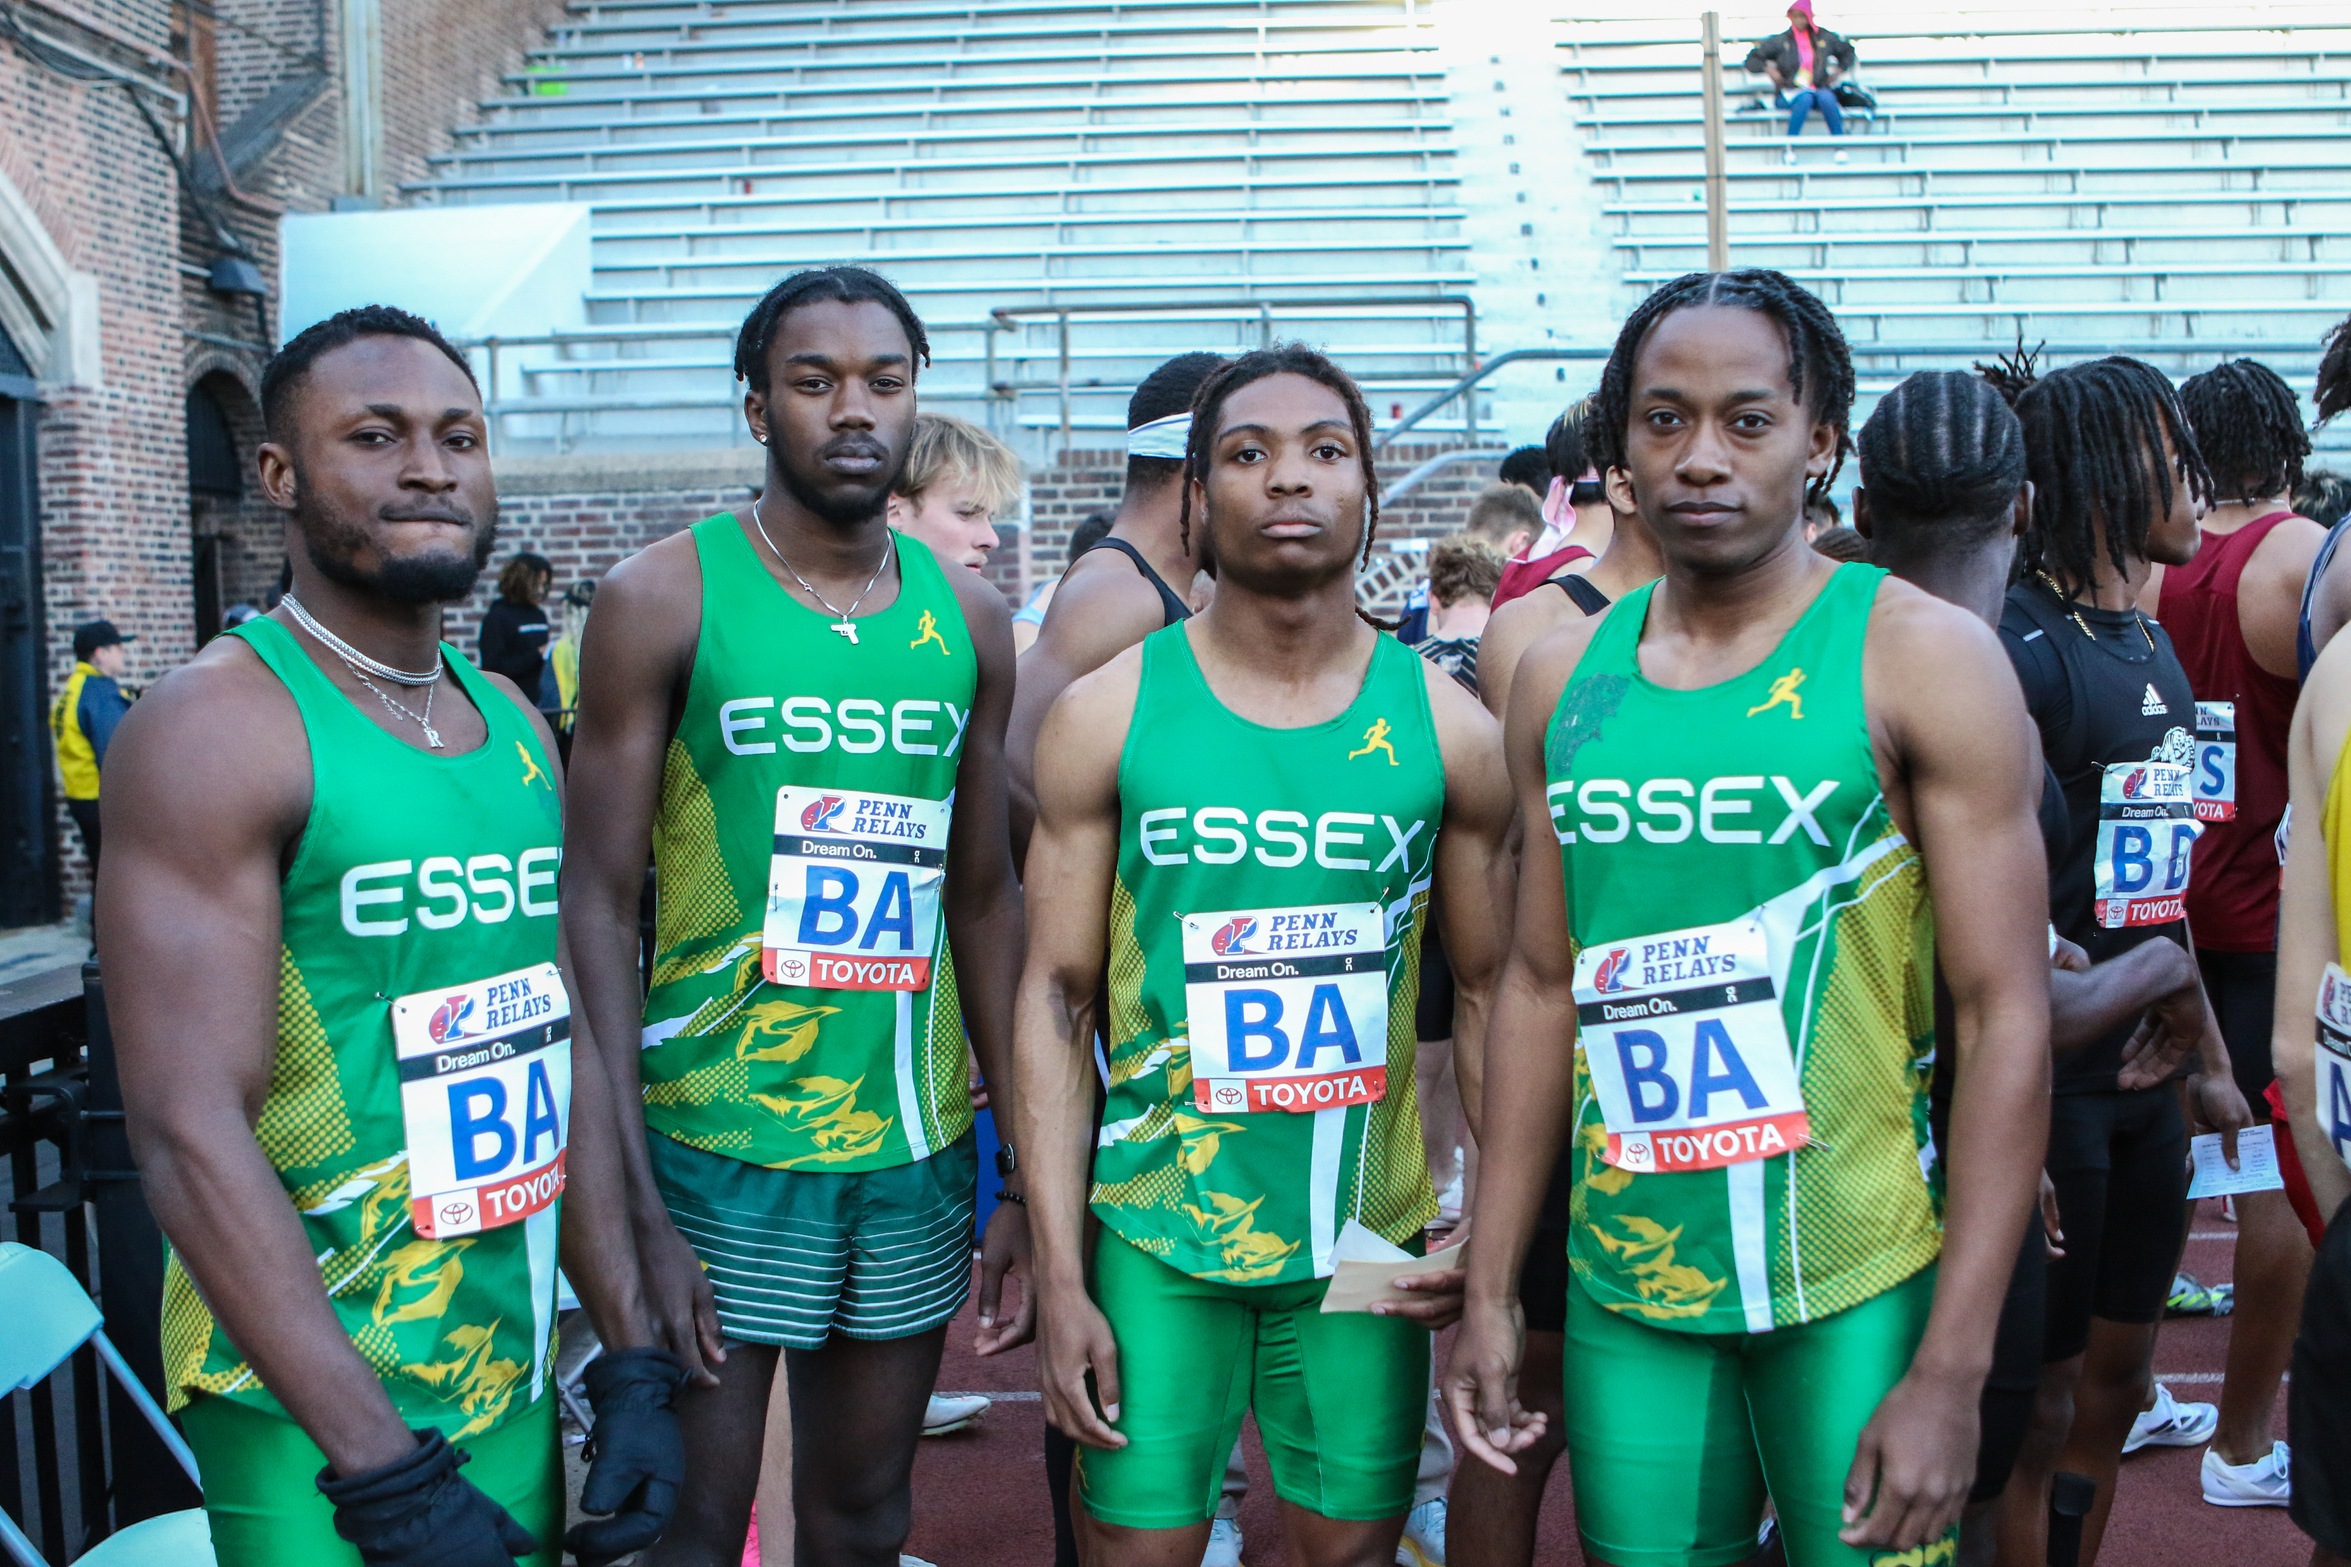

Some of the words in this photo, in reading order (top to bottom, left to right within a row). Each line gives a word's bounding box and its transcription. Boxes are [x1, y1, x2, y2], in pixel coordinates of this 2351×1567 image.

[2141, 704, 2168, 717] adidas
[719, 696, 969, 758] ESSEX
[856, 799, 913, 820] PENN
[1547, 775, 1841, 847] ESSEX
[2122, 806, 2154, 818] Dream
[2193, 802, 2224, 818] YOTA
[851, 817, 927, 839] RELAYS
[1140, 806, 1426, 874] ESSEX
[802, 840, 850, 857] Dream
[853, 844, 877, 859] On.
[340, 846, 563, 937] ESSE
[797, 864, 915, 951] BA
[1270, 912, 1338, 932] PENN
[2131, 898, 2182, 921] TOYOTA
[1267, 929, 1358, 951] RELAYS
[1642, 935, 1711, 963] PENN
[816, 958, 916, 985] TOYOTA
[1217, 965, 1268, 979] Dream
[1271, 962, 1300, 976] On.
[1643, 954, 1736, 985] RELAYS
[487, 977, 533, 1007] PENN
[486, 994, 552, 1030] RELAYS
[1603, 1002, 1649, 1021] Dream
[1649, 998, 1678, 1014] On.
[1224, 983, 1363, 1073] BA
[437, 1050, 490, 1074] Dream
[492, 1042, 516, 1060] On.
[1613, 1018, 1770, 1124] BA
[1253, 1075, 1368, 1107] TOYOTA
[447, 1058, 560, 1182] BA
[1656, 1124, 1786, 1163] TOYOTA
[486, 1162, 560, 1218] TOYOTA
